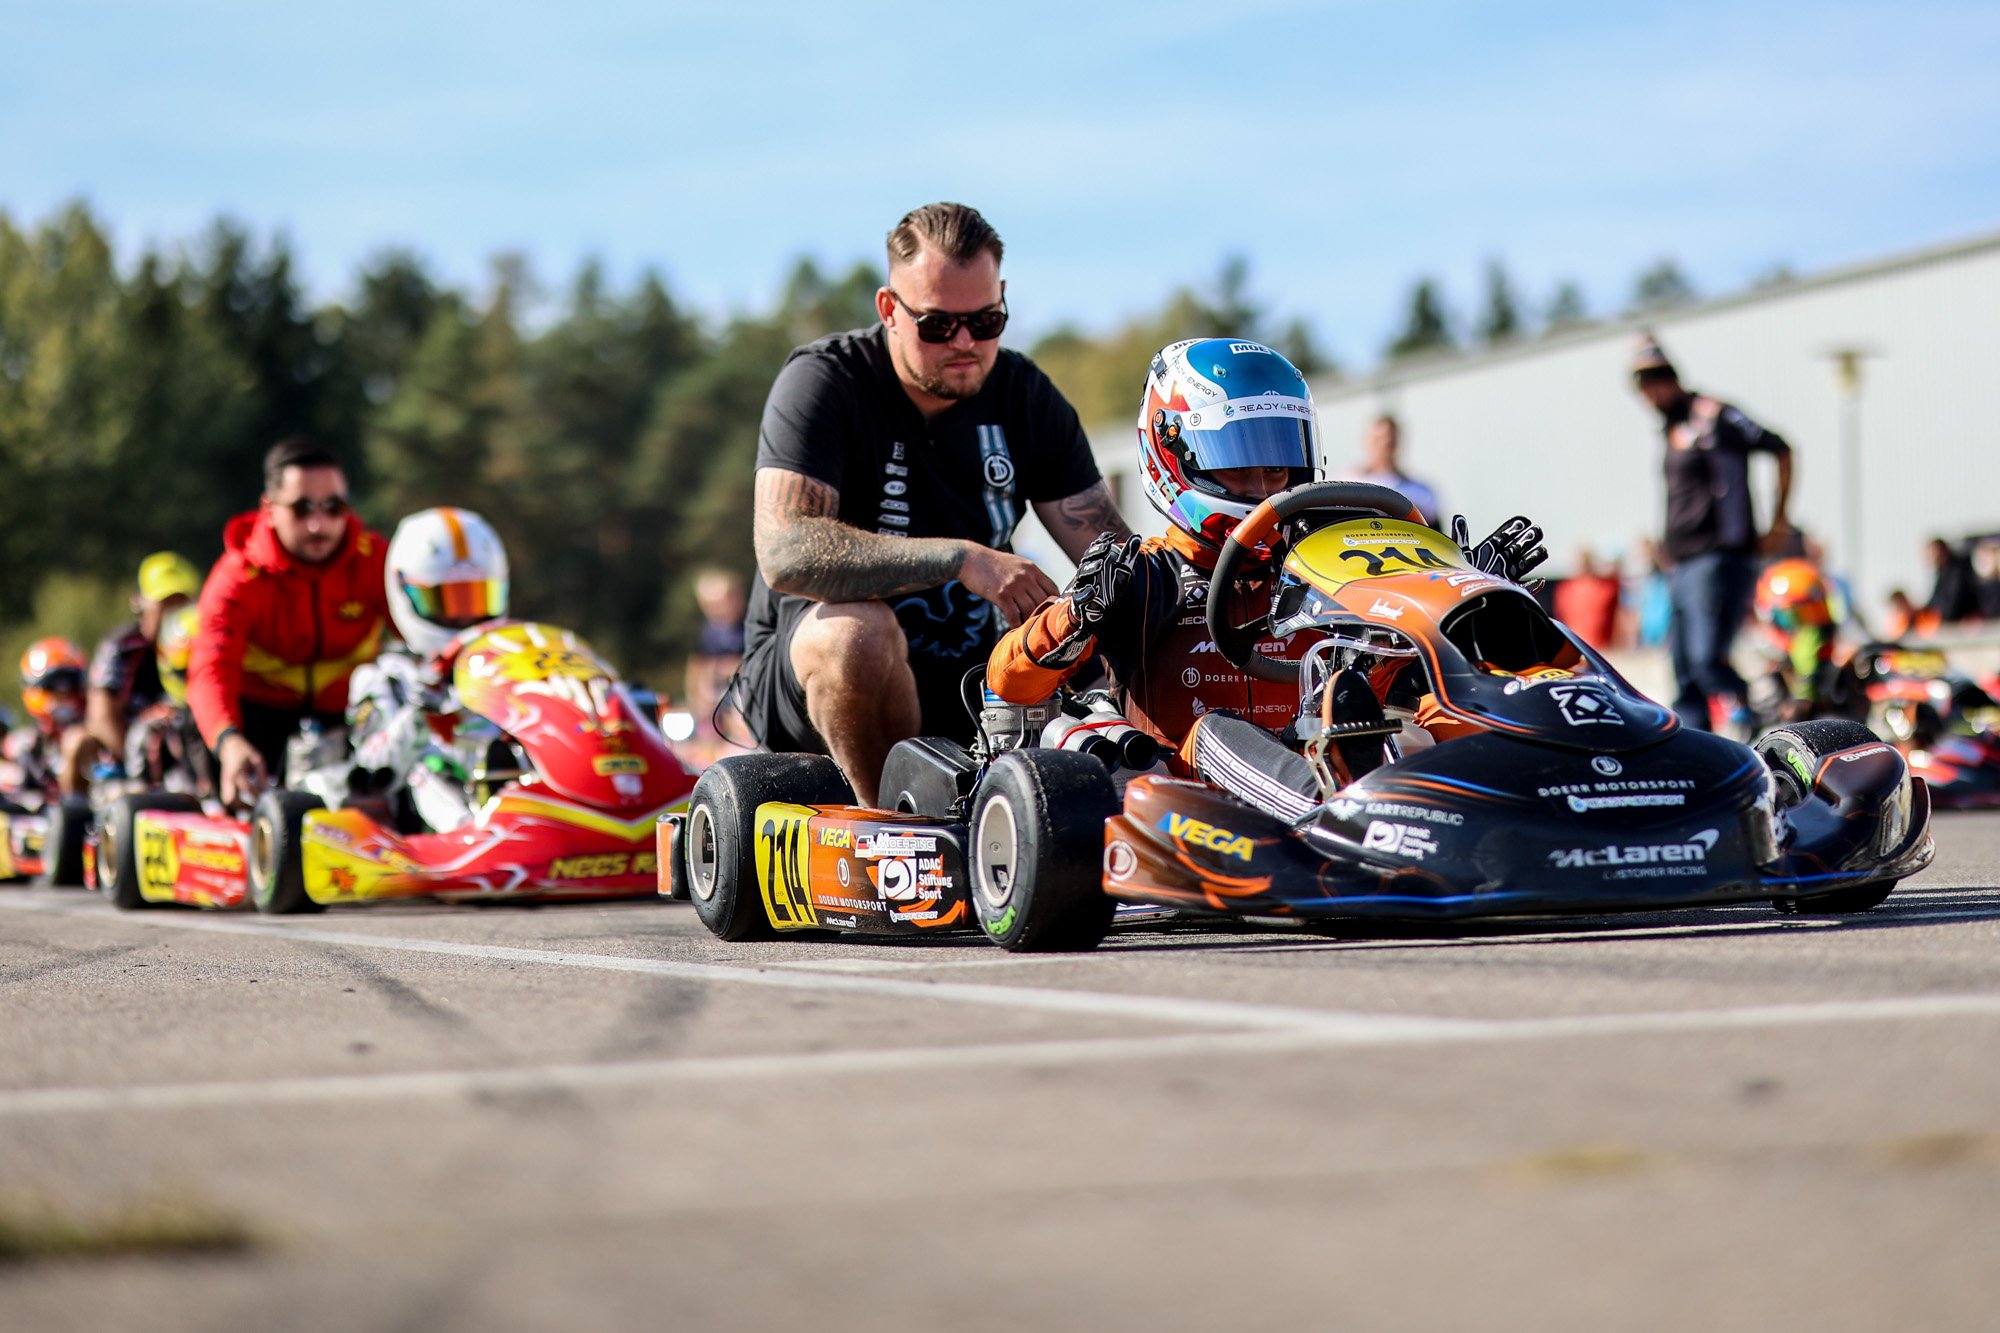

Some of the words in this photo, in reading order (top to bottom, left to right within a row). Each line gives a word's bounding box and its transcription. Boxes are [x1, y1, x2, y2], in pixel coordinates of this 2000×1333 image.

[1233, 344, 1269, 353] MOL
[1339, 546, 1463, 576] 214
[1205, 674, 1239, 682] DOERR
[1537, 783, 1591, 797] DOERR
[1594, 780, 1696, 792] MOTORSPORT
[820, 827, 851, 848] VEGA
[1169, 812, 1254, 862] VEGA
[918, 858, 941, 871] ADAC
[1548, 844, 1705, 868] McLaren
[762, 819, 815, 923] 214
[918, 873, 953, 888] Stiftung
[918, 887, 943, 901] Sport
[818, 894, 839, 906] DOERR
[840, 896, 887, 912] MOTORSPORT
[826, 916, 856, 928] McLaren
